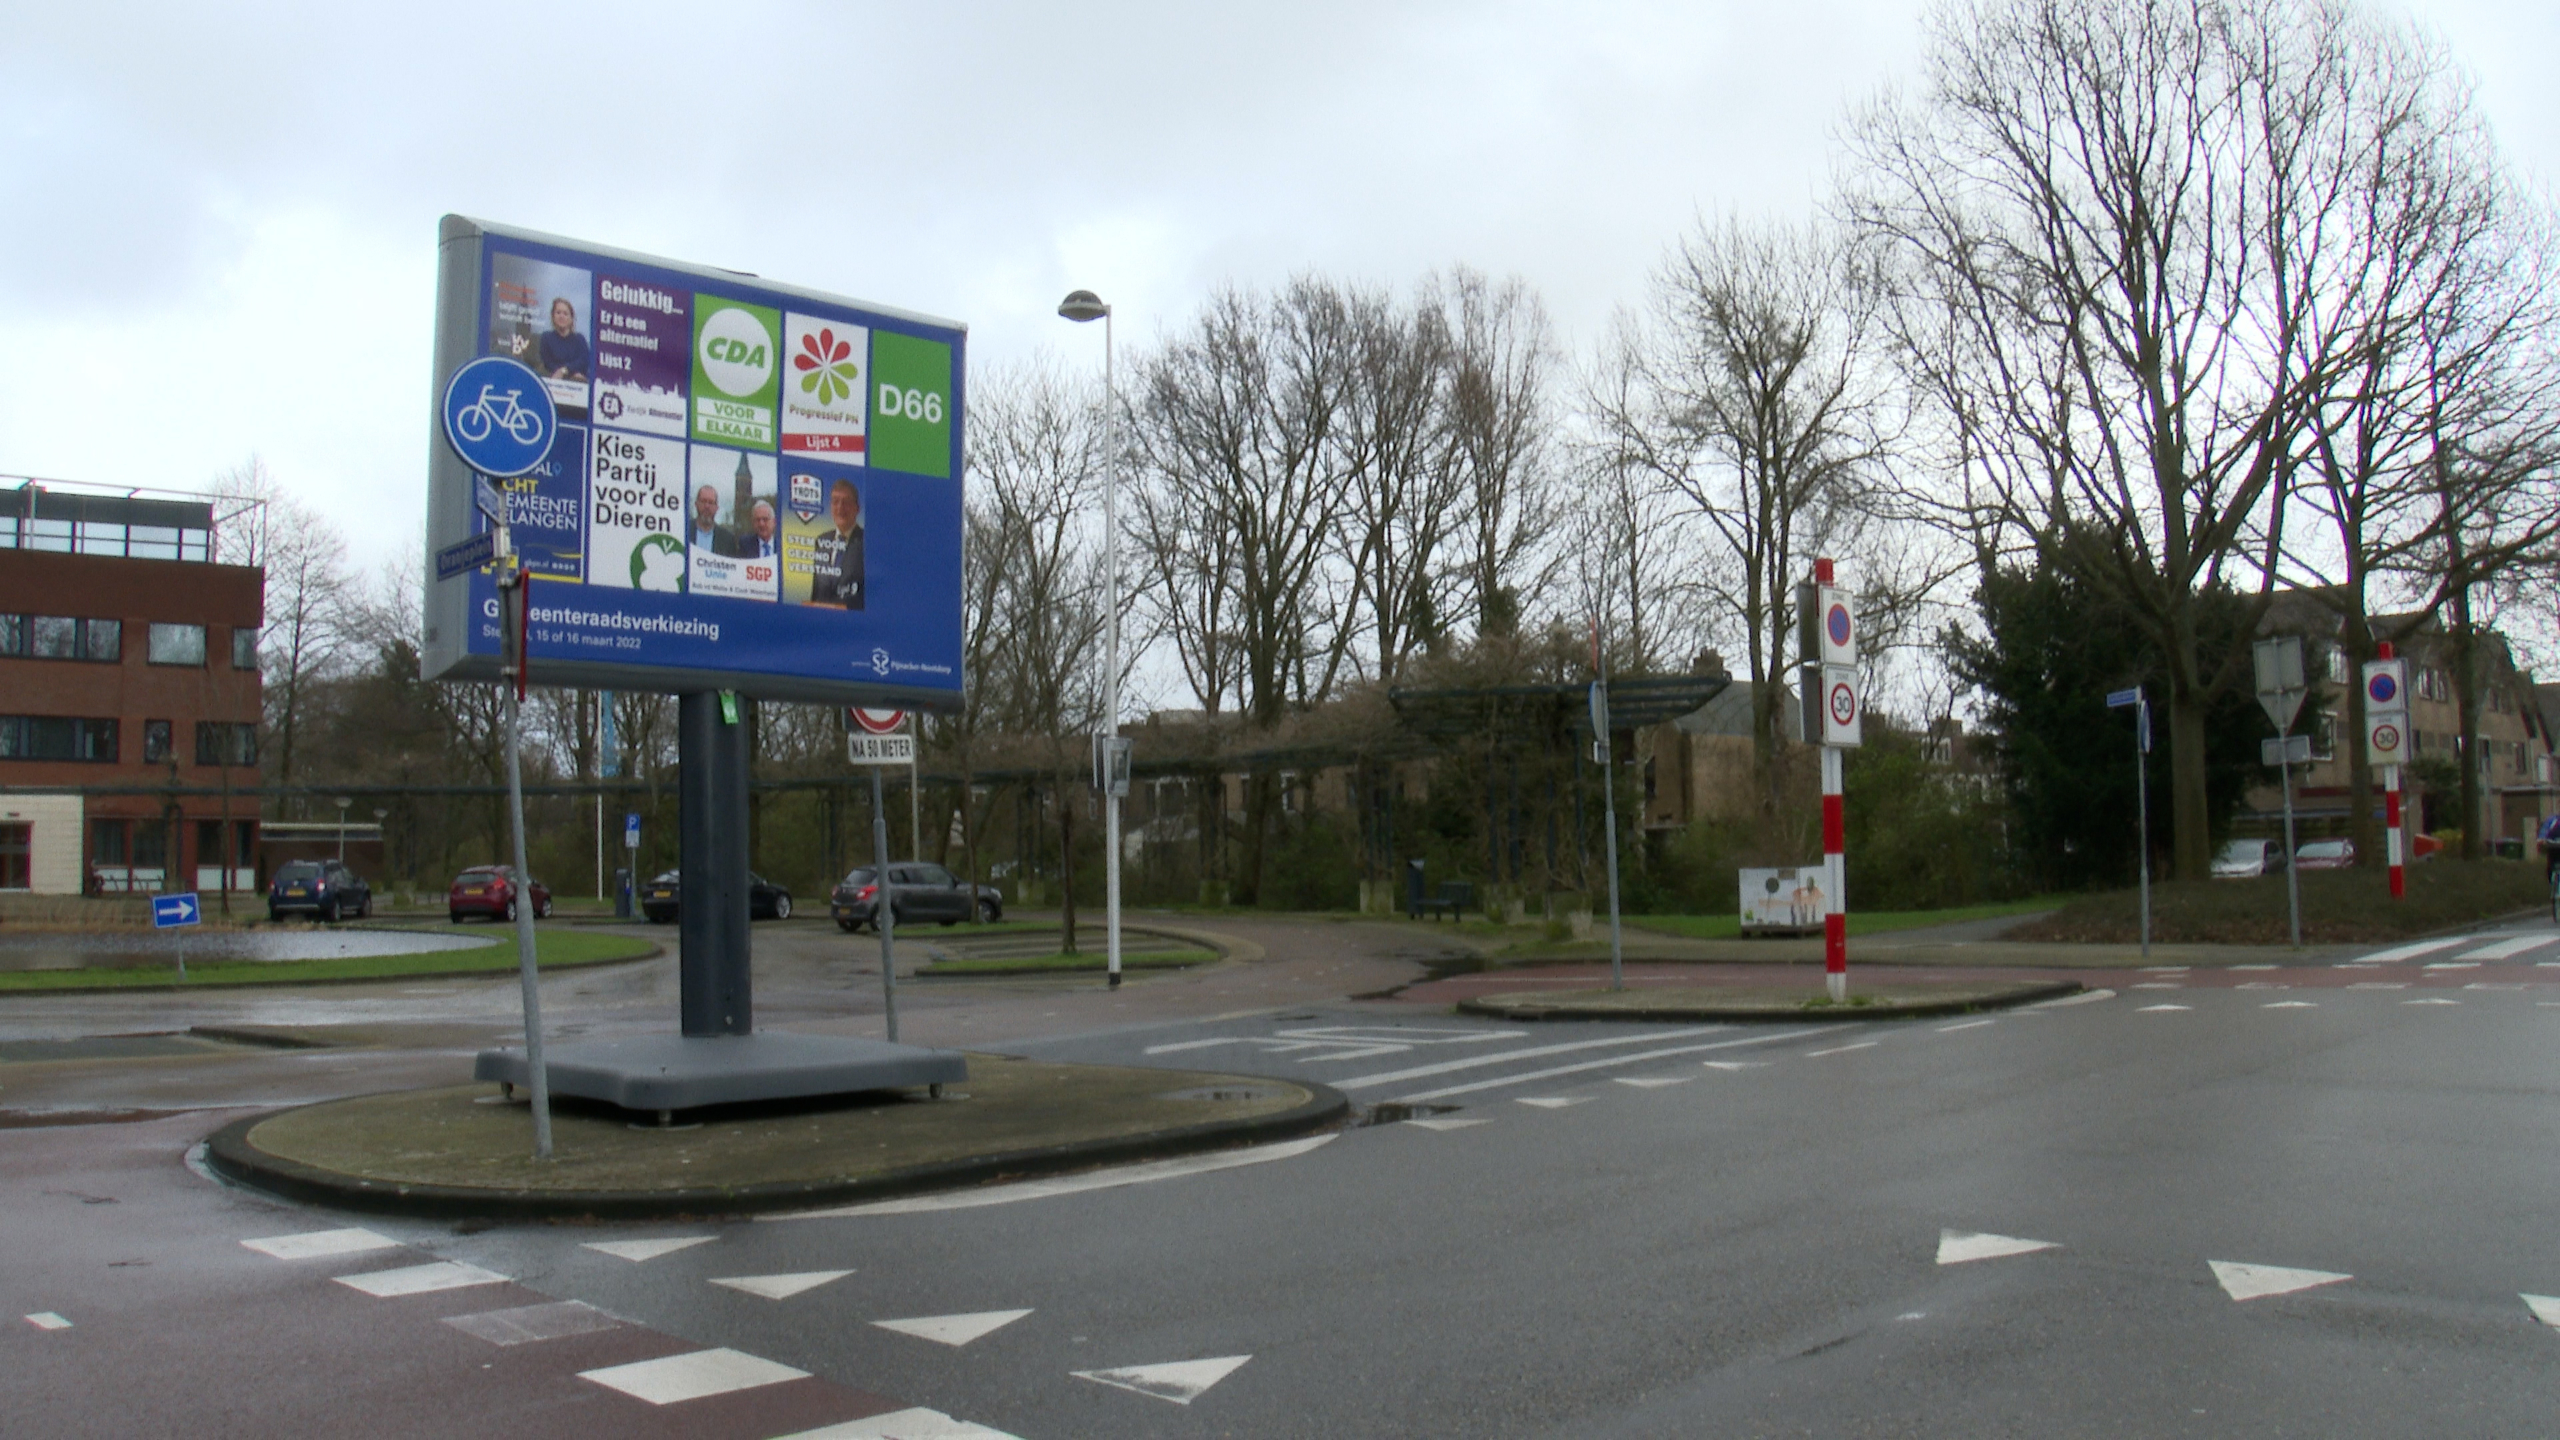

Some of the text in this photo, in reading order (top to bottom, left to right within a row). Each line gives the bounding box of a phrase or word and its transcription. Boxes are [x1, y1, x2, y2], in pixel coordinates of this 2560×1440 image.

[600, 310, 646, 331] Er is een
[600, 329, 659, 351] alternatief
[600, 352, 632, 371] Lijst 2
[707, 337, 765, 369] CDA
[714, 402, 756, 421] VOOR
[879, 383, 943, 424] D66
[789, 404, 843, 424] Progressief
[706, 420, 763, 441] ELKAAR
[598, 433, 646, 461] Kies
[806, 435, 841, 452] Lijst 4
[596, 457, 656, 491] Partij
[502, 477, 539, 495] CHT
[505, 492, 578, 516] EMEENTE
[595, 486, 680, 511] voor de
[596, 503, 671, 533] Dieren
[788, 534, 847, 551] STEM VOOR
[697, 557, 737, 571] Christen
[788, 550, 830, 562] GEZOND
[746, 565, 772, 582] SGP
[788, 562, 842, 577] VERSTAND
[850, 582, 859, 596] 9
[483, 598, 719, 641] Geenteraadsverkiezing
[483, 624, 502, 638] Ste
[537, 629, 549, 641] 15
[552, 631, 564, 643] of
[567, 632, 580, 644] 16
[582, 635, 613, 648] maart
[616, 636, 642, 649] 2022
[1835, 696, 1850, 713] 30
[852, 738, 911, 757] NA 50 METER
[2380, 732, 2395, 744] 30
[628, 816, 637, 829] P
